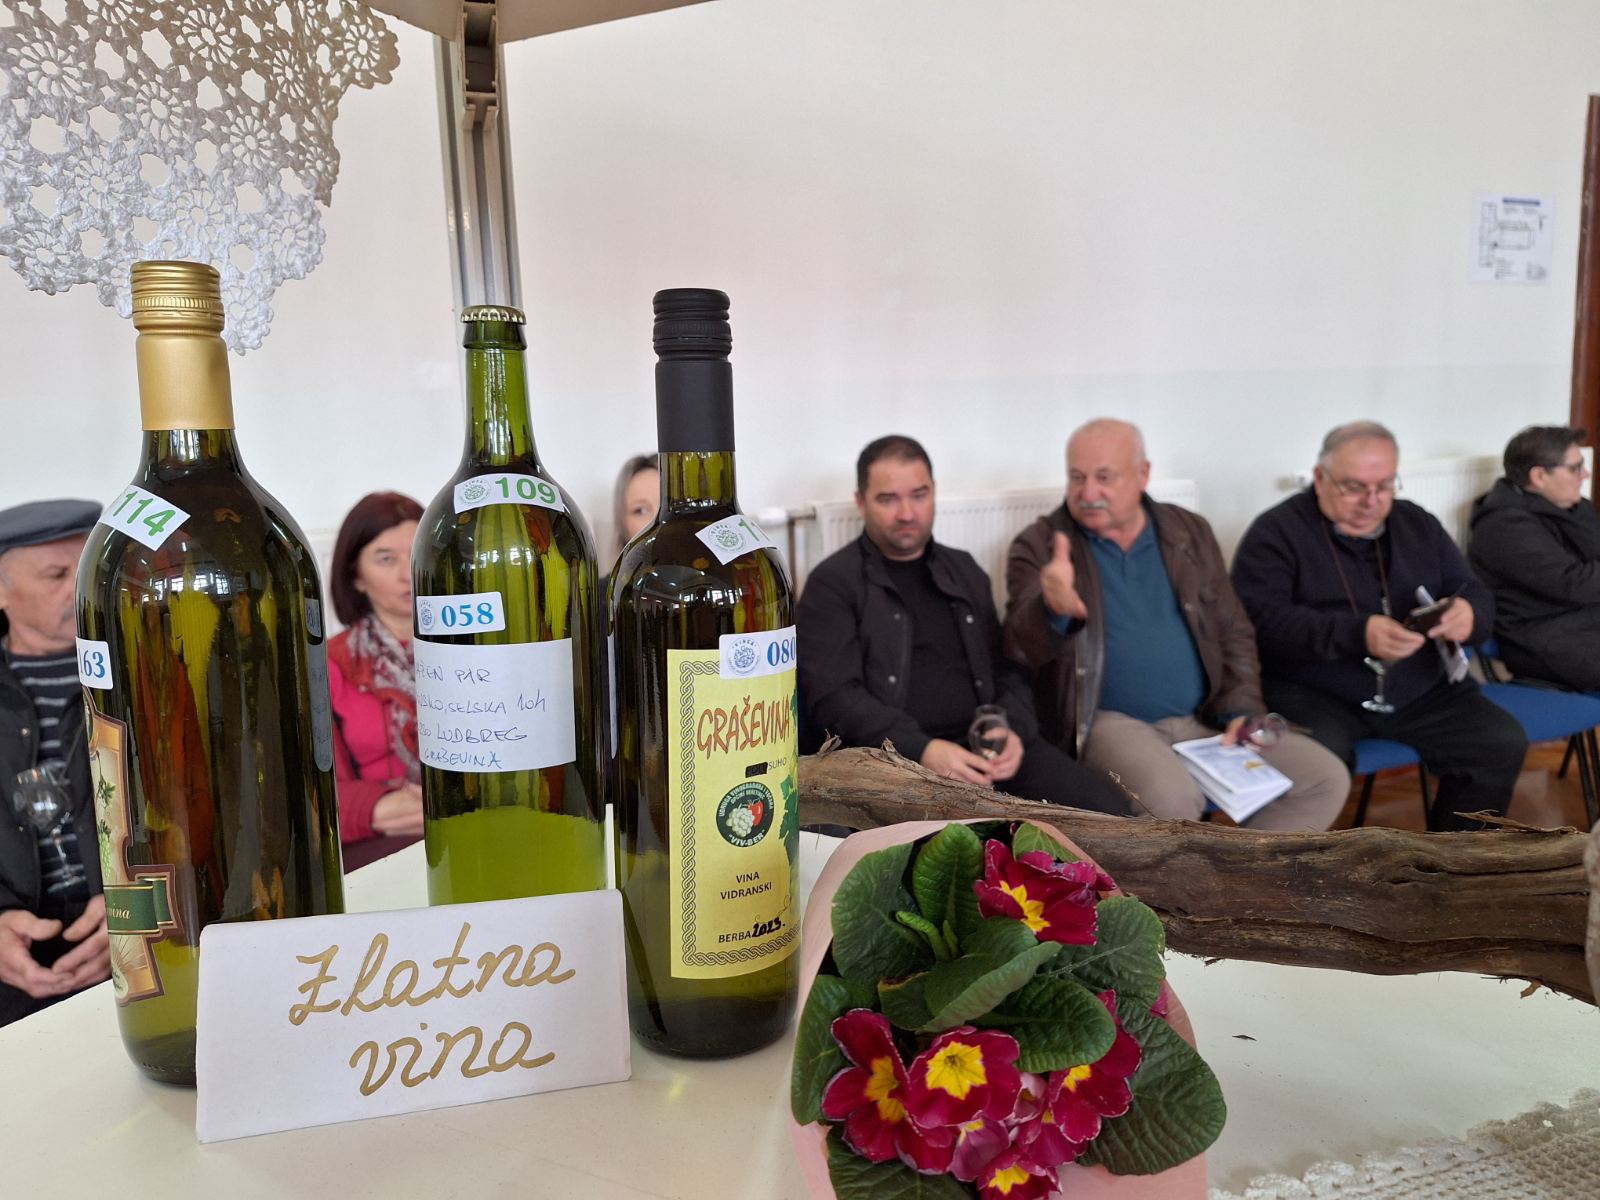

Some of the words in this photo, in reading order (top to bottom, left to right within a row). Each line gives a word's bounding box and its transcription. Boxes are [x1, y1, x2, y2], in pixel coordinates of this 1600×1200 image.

[495, 477, 556, 504] 109
[113, 490, 176, 537] 114
[441, 602, 494, 628] 058
[78, 648, 106, 679] 63
[437, 722, 529, 743] LUDBREG
[697, 694, 791, 760] GRAŠEVINA
[768, 757, 788, 771] SUHO
[735, 871, 760, 884] VINA
[720, 881, 773, 901] VIDRANSKI
[718, 930, 752, 944] BERBA
[751, 916, 786, 938] 2023.
[289, 921, 577, 1027] Zlatna
[349, 1020, 556, 1097] vina
